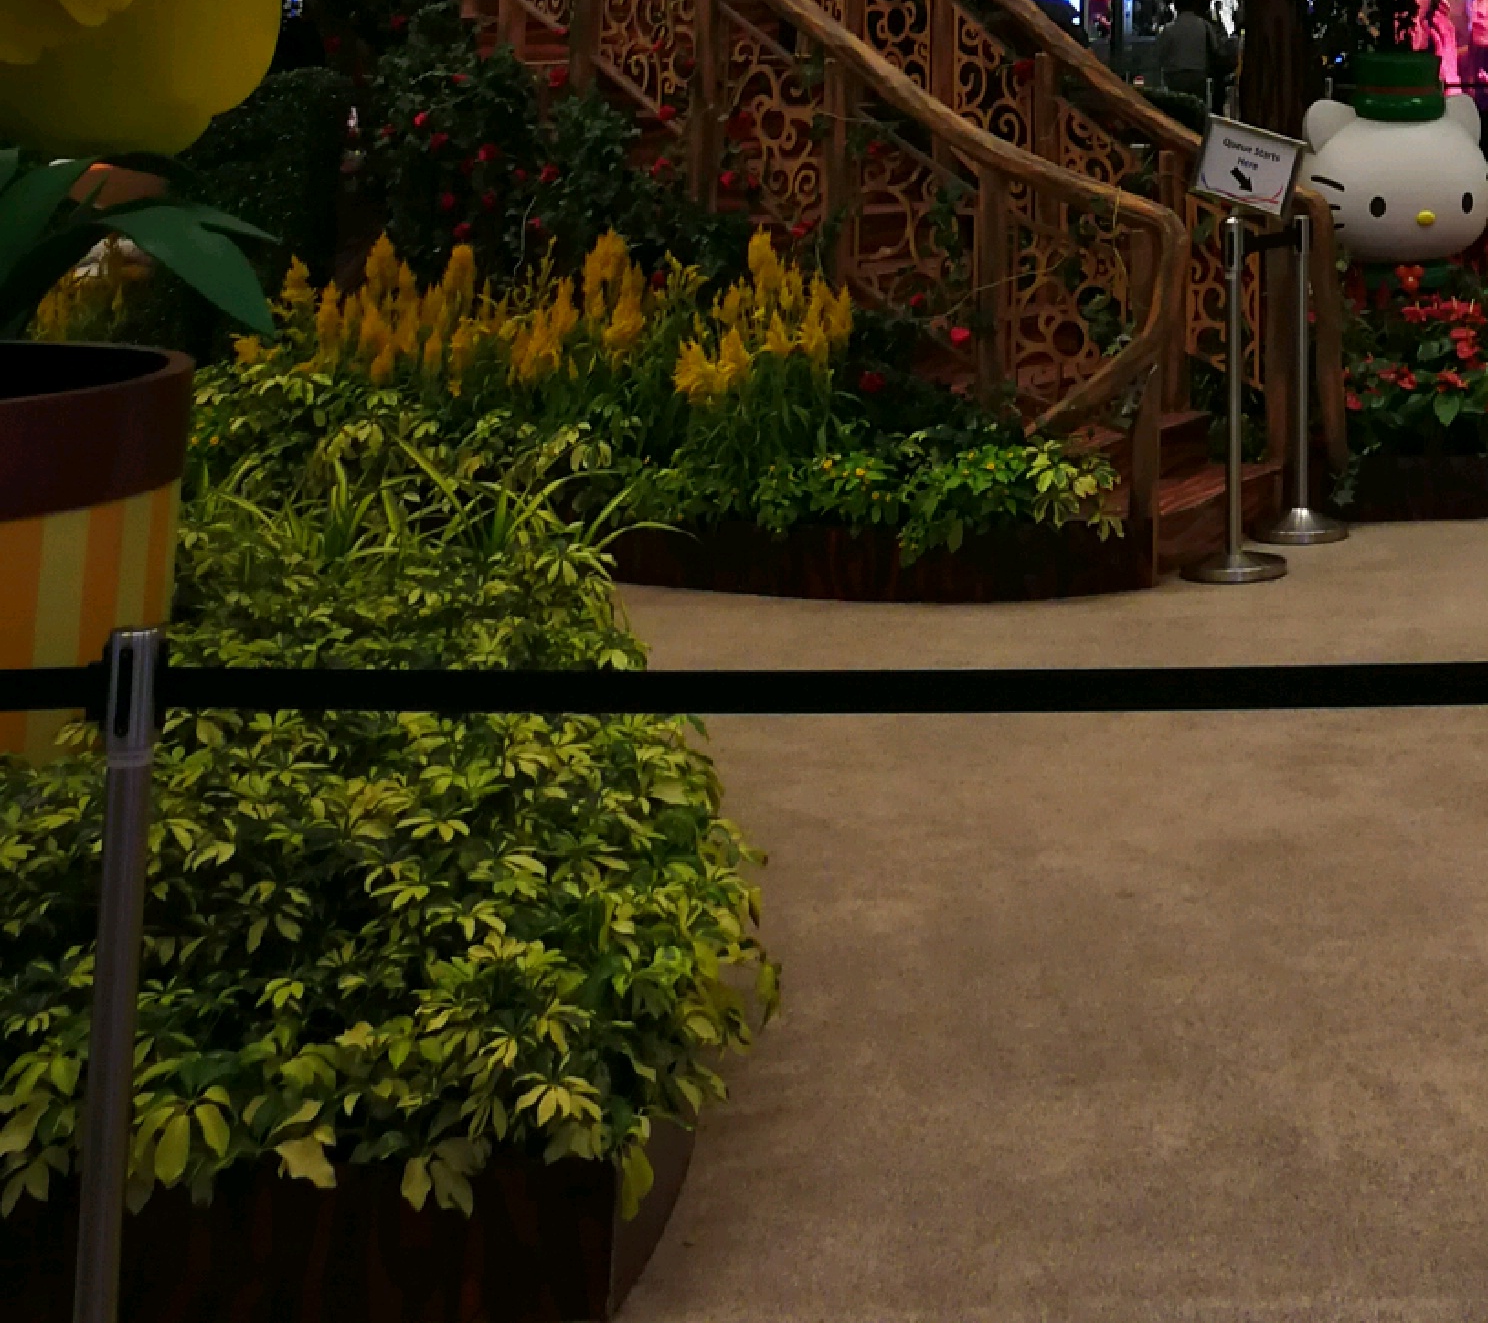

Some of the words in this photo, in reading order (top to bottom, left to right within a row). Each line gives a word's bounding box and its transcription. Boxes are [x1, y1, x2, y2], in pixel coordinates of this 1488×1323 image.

[1222, 138, 1252, 153] Queue
[1254, 147, 1281, 162] Starts
[1238, 157, 1258, 170] Here
